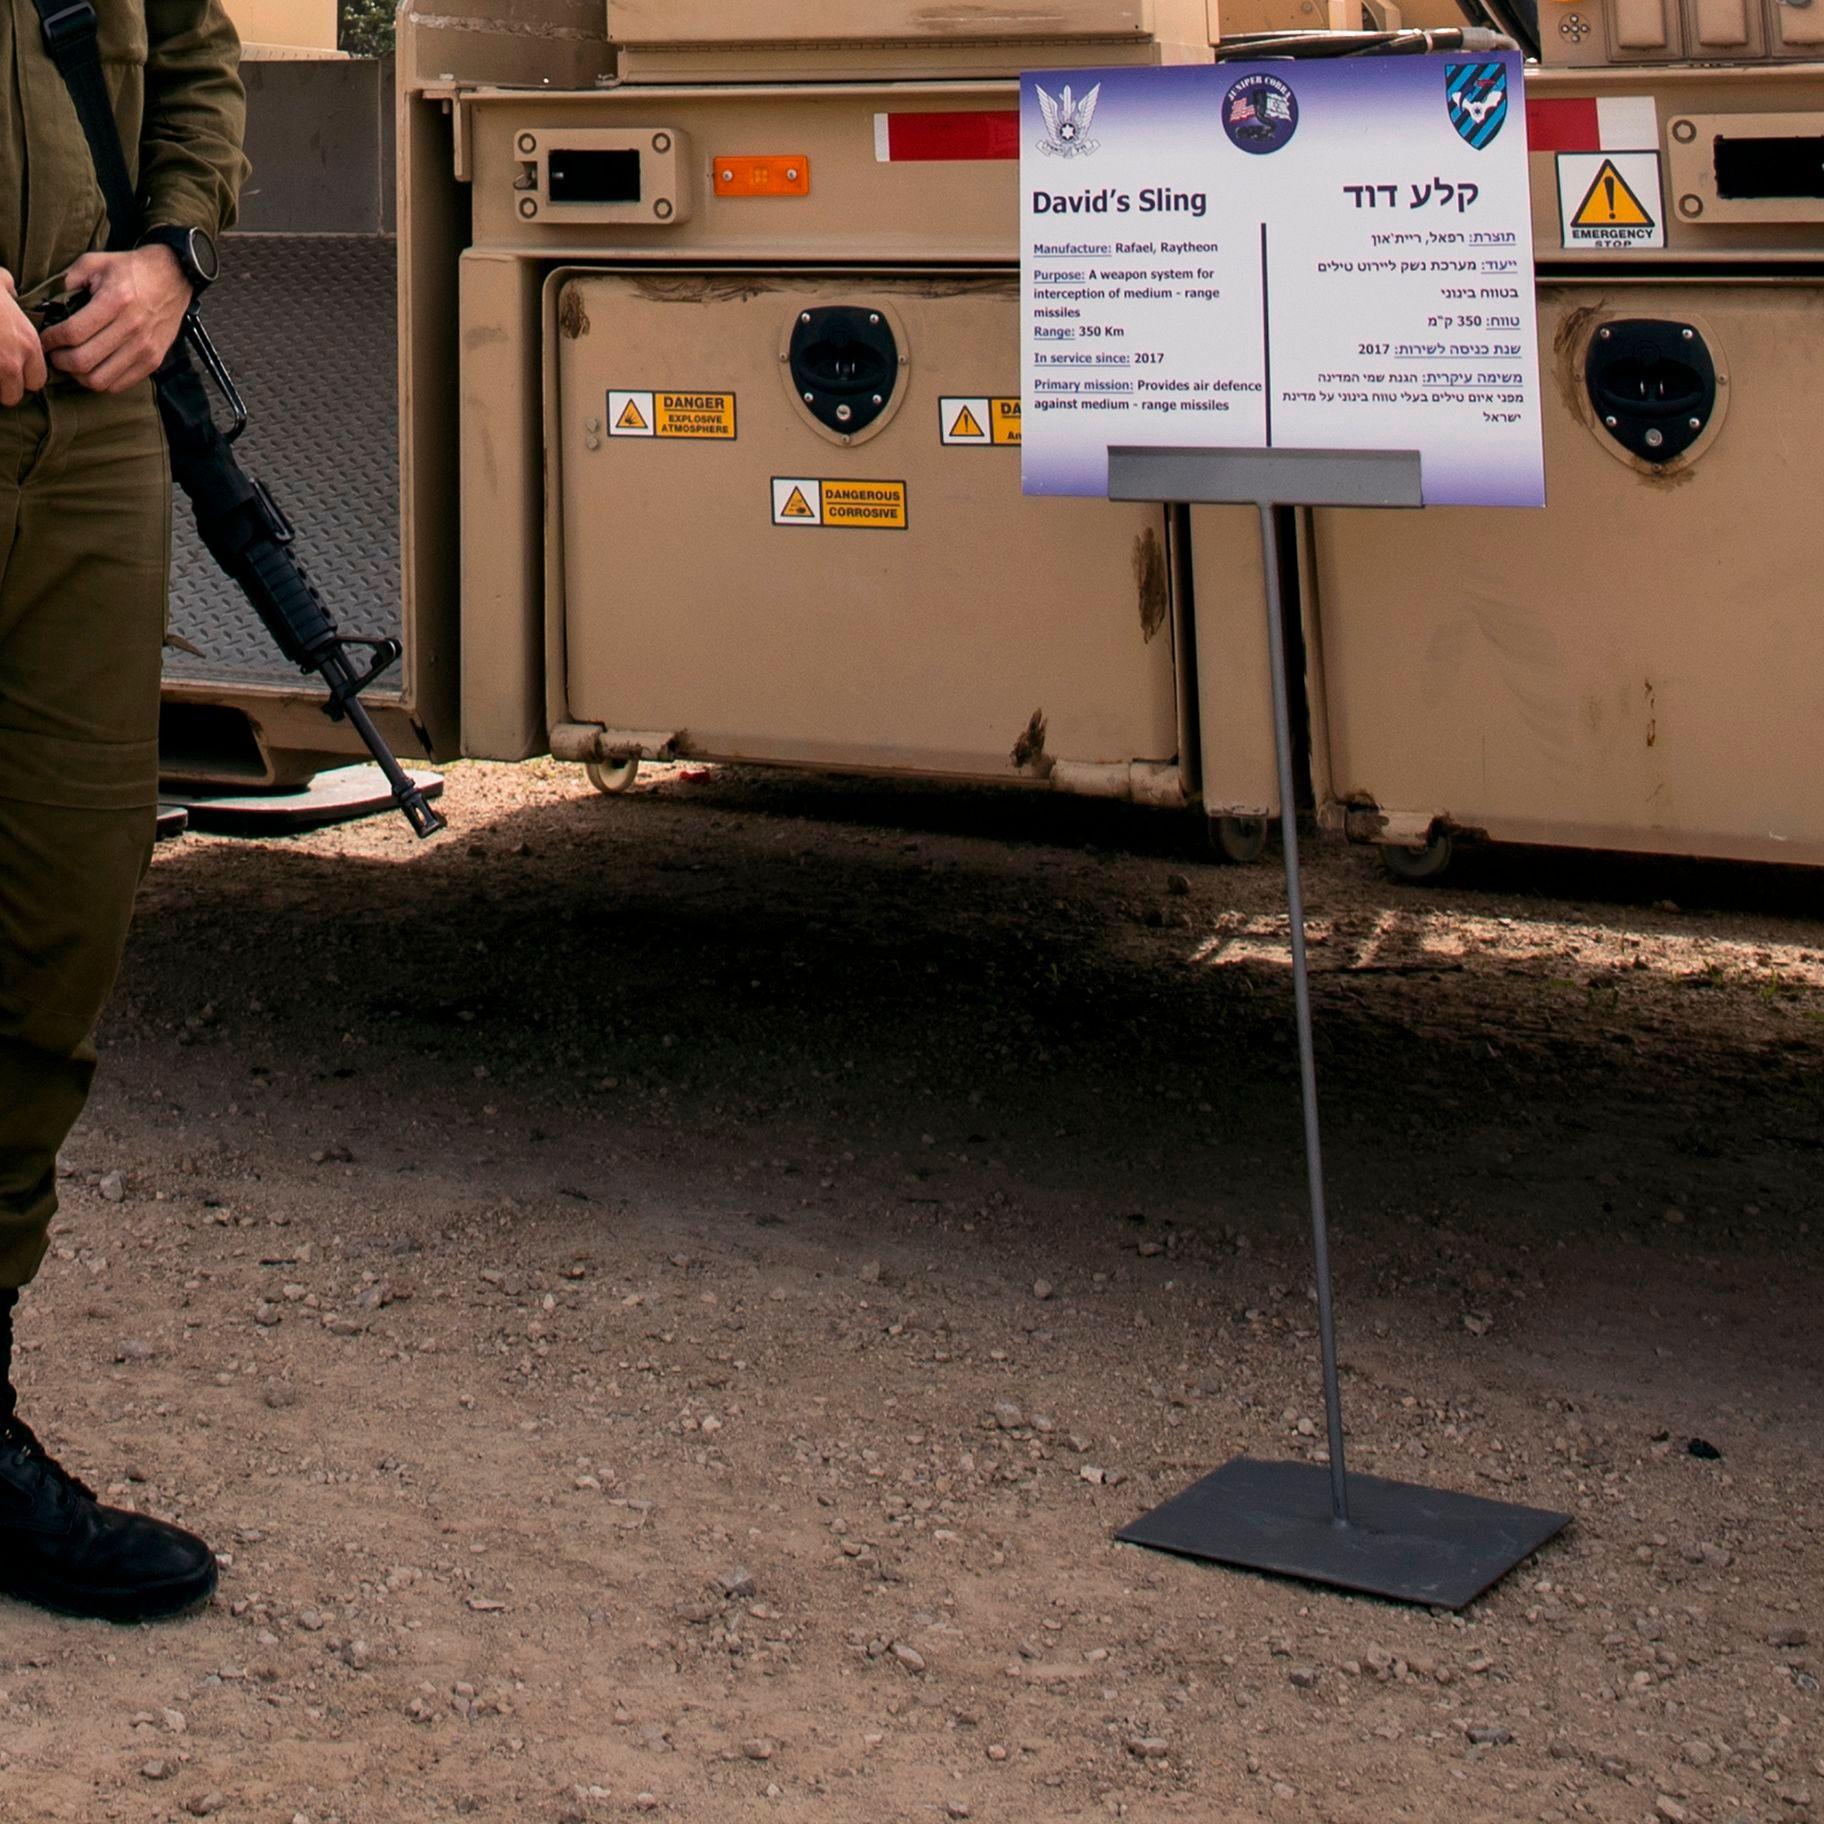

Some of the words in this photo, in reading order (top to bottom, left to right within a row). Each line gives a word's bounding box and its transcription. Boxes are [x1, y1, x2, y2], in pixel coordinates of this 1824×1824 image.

[1228, 75, 1263, 101] JUNIPER
[1343, 184, 1398, 208] דוד
[1410, 177, 1479, 212] קלע
[1139, 188, 1207, 217] Sling
[1425, 231, 1465, 246] רפאל,
[1468, 231, 1516, 243] תוצרת:
[1572, 229, 1653, 239] EMERGENCY
[1033, 243, 1112, 255] Manufacture:
[1115, 242, 1157, 255] Rafael,
[1160, 241, 1218, 256] Raytheon
[1596, 240, 1632, 248] STOP
[1317, 261, 1354, 272] טילים
[1357, 260, 1397, 272] ליירוט
[1401, 262, 1426, 274] נשק
[1430, 260, 1477, 271] מערכת
[1481, 260, 1518, 272] ייעוד:
[1033, 269, 1086, 283] Purpose:
[1088, 269, 1099, 280] A
[1100, 270, 1147, 283] weapon
[1150, 270, 1194, 283] system
[1196, 268, 1214, 279] for
[1033, 287, 1105, 302] interception
[1108, 287, 1121, 299] of
[1123, 287, 1173, 299] medium
[1184, 288, 1220, 301] range
[1440, 288, 1477, 299] בינוני
[1480, 287, 1519, 299] בטווח
[1034, 306, 1081, 318] missiles
[1457, 315, 1482, 327] 350
[1486, 315, 1521, 328] טווח:
[1034, 325, 1076, 339] Range:
[1078, 326, 1101, 337] 350
[1105, 326, 1124, 337] Km
[1358, 343, 1390, 355] 2017
[1394, 342, 1447, 355] לשירות:
[1449, 344, 1490, 355] כניסה
[1493, 344, 1522, 355] שנת
[1034, 353, 1047, 364] In
[1050, 353, 1092, 364] service
[1095, 353, 1130, 364] since:
[1134, 353, 1164, 364] 2017
[1318, 373, 1360, 383] המדינה
[1363, 373, 1385, 383] שמי
[1388, 373, 1418, 383] הגנת
[1422, 372, 1473, 386] עיקרית:
[1477, 372, 1523, 384] משימה
[1034, 379, 1081, 392] Primary
[1083, 379, 1134, 390] mission:
[1137, 380, 1189, 391] Provides
[1193, 380, 1210, 391] air
[1213, 380, 1262, 392] defence
[1282, 391, 1317, 402] מדינת
[1319, 391, 1335, 402] על
[1337, 392, 1369, 402] בינוני
[1371, 392, 1397, 403] טווח
[1400, 391, 1428, 403] בעלי
[1431, 391, 1465, 403] טילים
[1468, 393, 1494, 403] איום
[1497, 392, 1524, 403] מפני
[663, 397, 725, 409] DANGER
[1034, 398, 1077, 412] against
[1081, 399, 1129, 410] medium
[1141, 401, 1177, 413] range
[1180, 399, 1229, 411] missiles
[668, 414, 722, 424] EXPLOSIVE
[1483, 411, 1522, 423] ישראל
[661, 424, 729, 434] ATMOSPHERE
[824, 489, 900, 501] DANGEROUS
[828, 507, 898, 519] CORROSIVE
